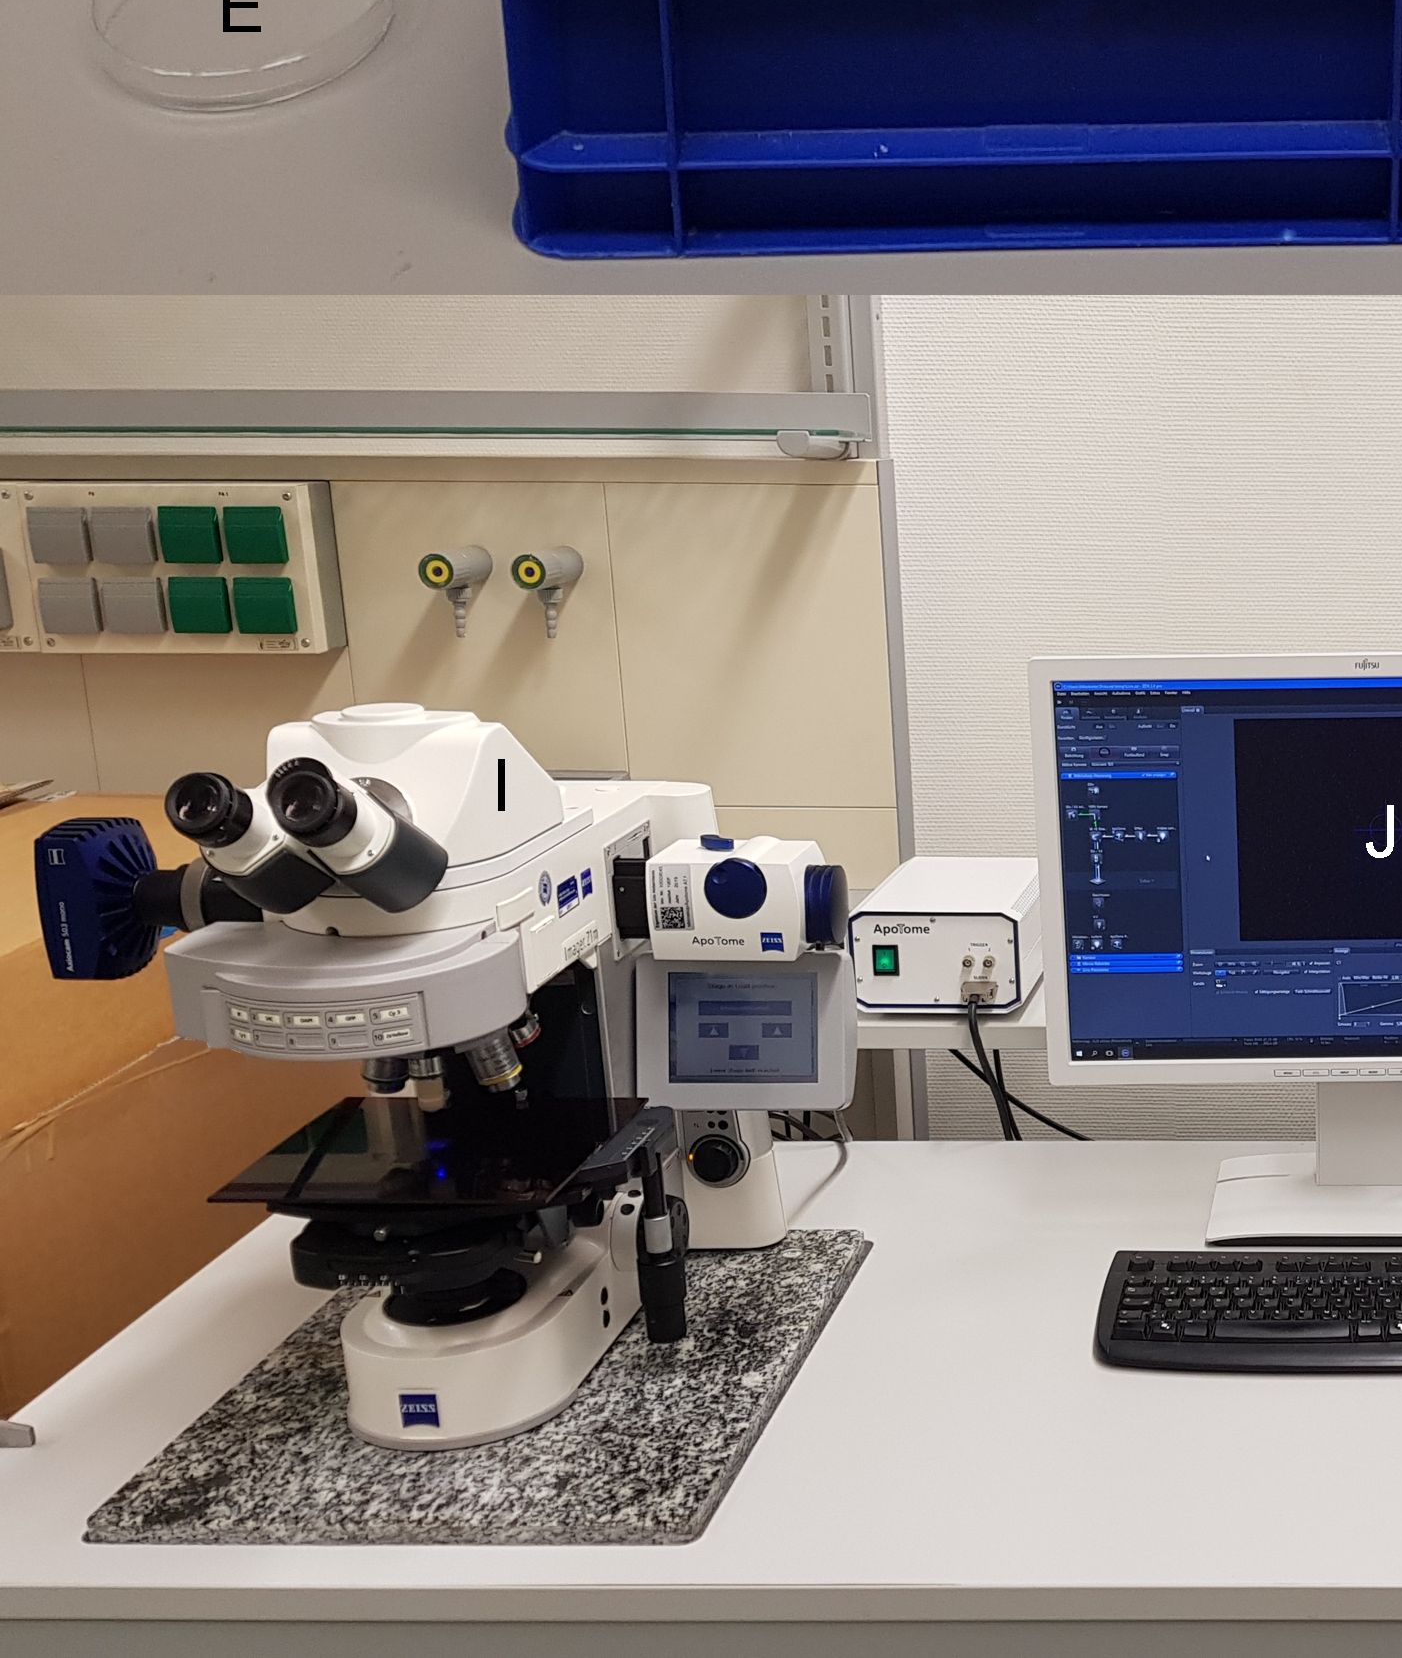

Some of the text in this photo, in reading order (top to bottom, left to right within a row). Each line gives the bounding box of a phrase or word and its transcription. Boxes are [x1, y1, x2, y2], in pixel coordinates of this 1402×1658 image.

[1354, 658, 1380, 670] FUJITSU
[60, 923, 70, 937] 503
[873, 924, 930, 936] ApoTome
[692, 936, 745, 946] ApoTome
[64, 939, 74, 972] Axiocam
[401, 1404, 436, 1413] ZEISS
